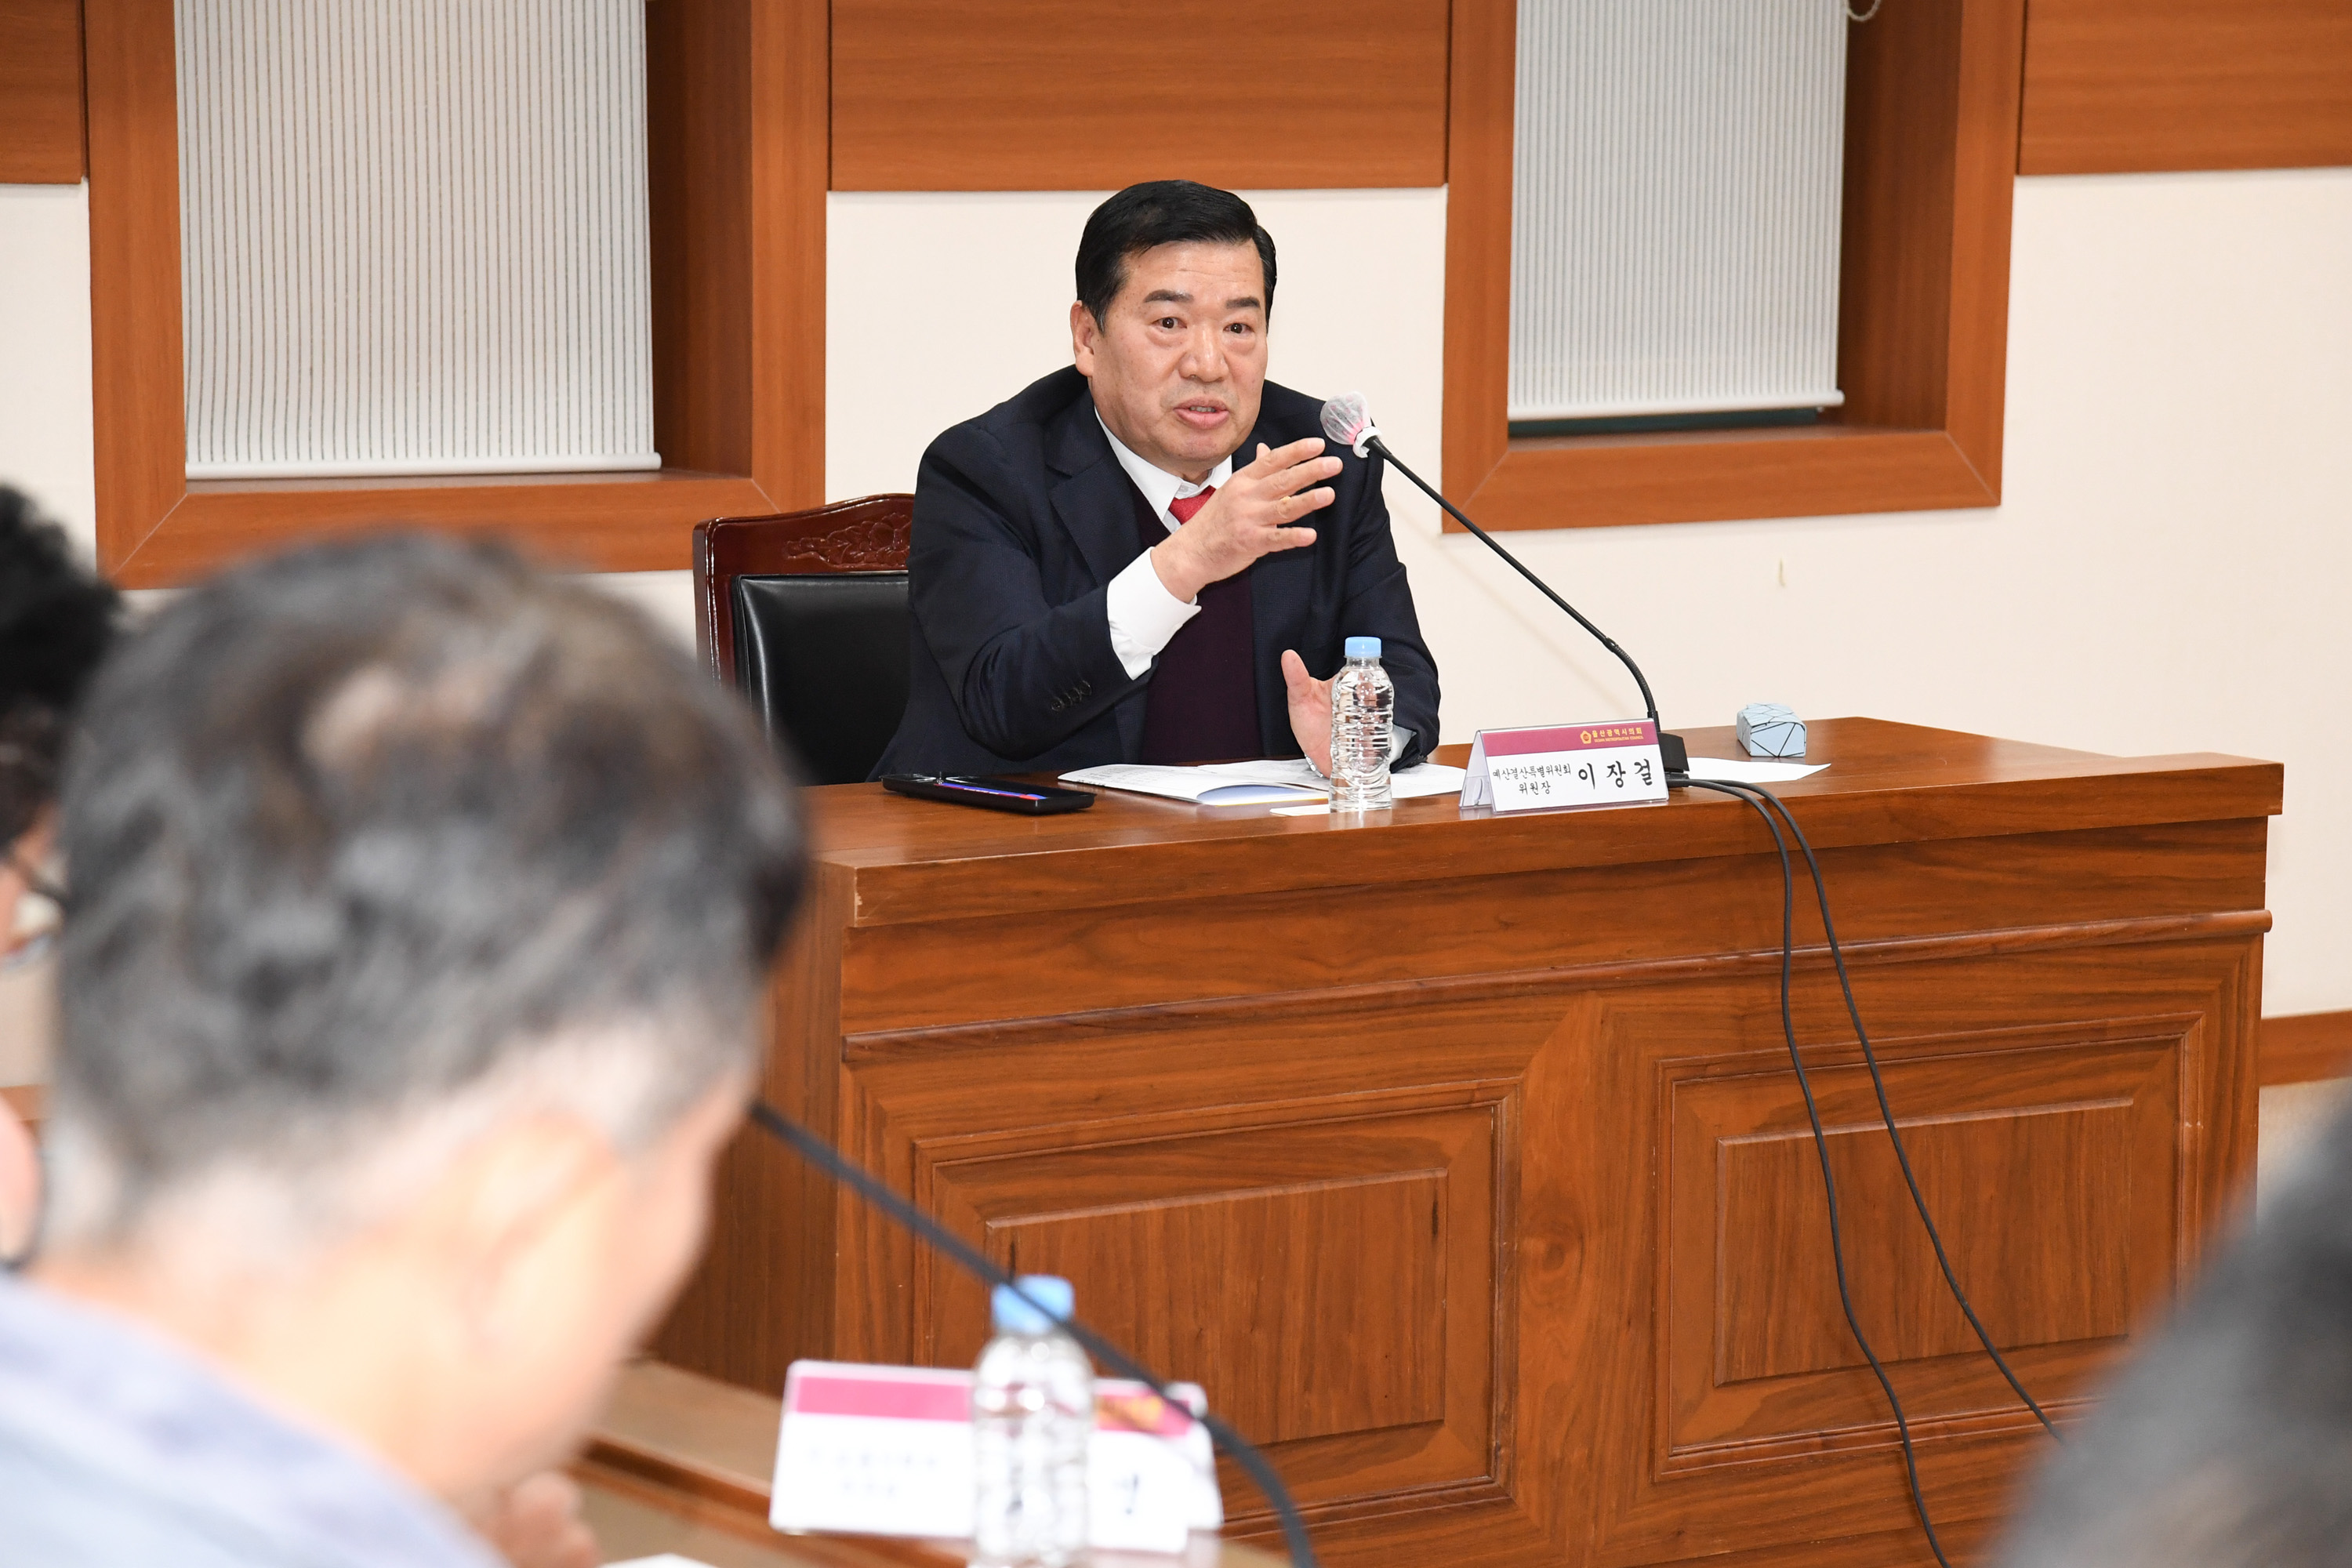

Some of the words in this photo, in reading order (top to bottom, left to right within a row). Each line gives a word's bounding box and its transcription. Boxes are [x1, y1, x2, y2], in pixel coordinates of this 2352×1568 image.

[1592, 727, 1642, 738] 울산광역시의회
[1492, 763, 1572, 781] 예산결산특별위원회
[1519, 780, 1552, 796] 위원장
